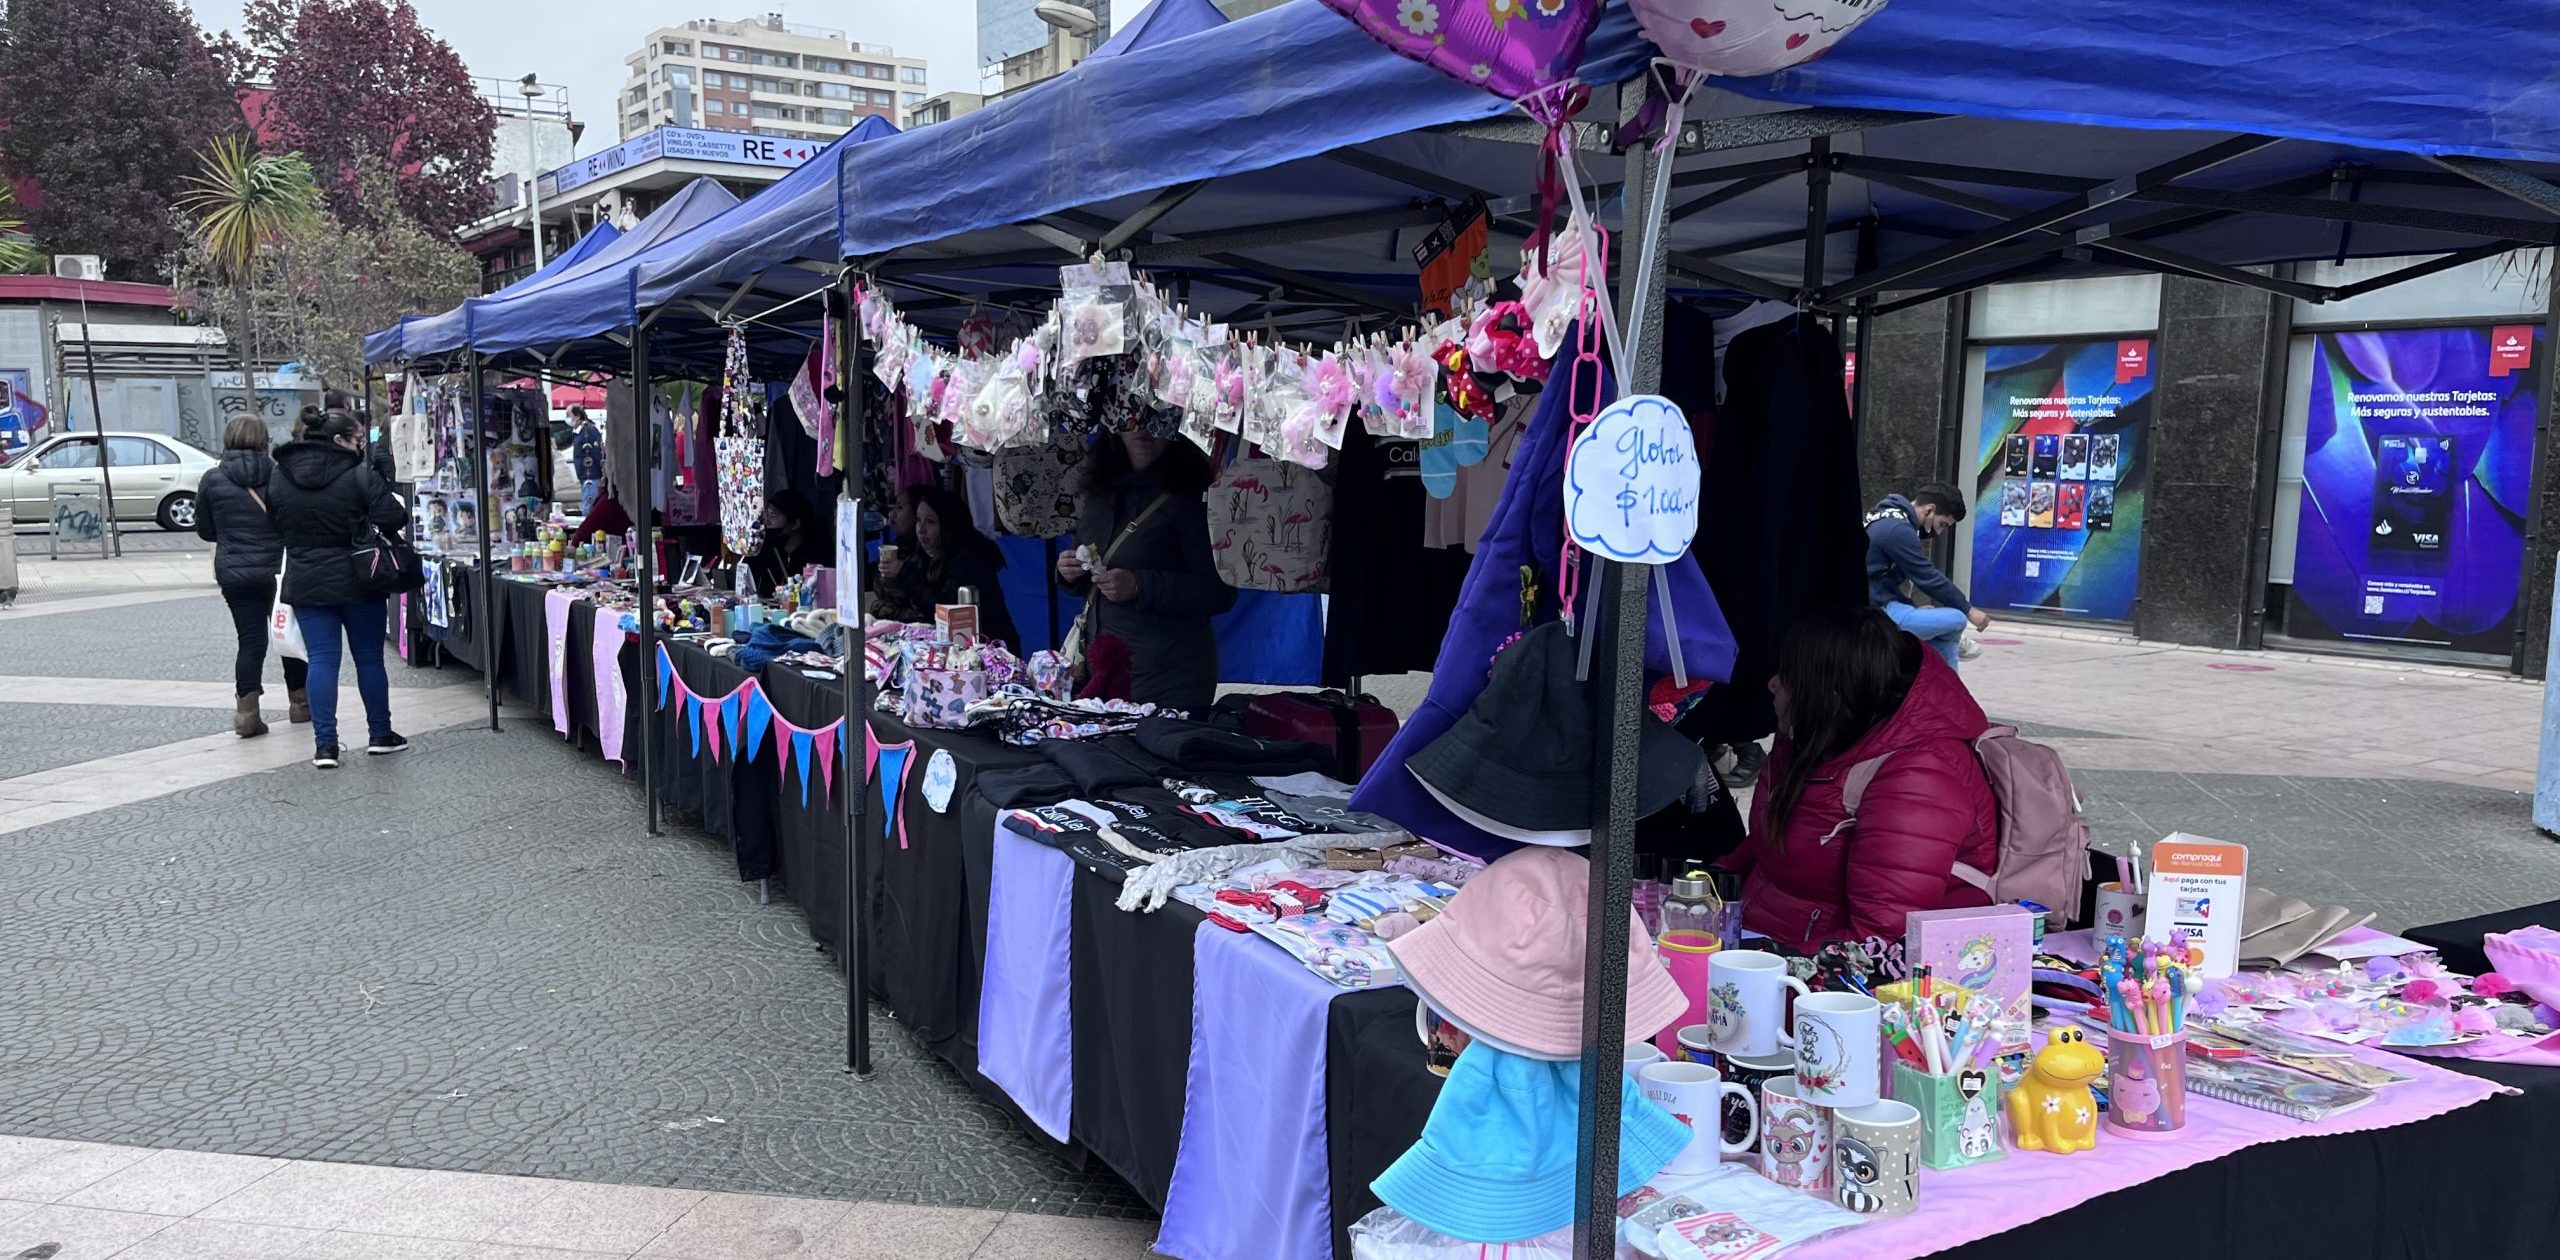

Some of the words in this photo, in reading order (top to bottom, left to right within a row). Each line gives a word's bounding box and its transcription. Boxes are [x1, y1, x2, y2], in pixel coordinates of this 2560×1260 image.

[743, 139, 776, 160] RE
[2010, 396, 2053, 406] Renovamos
[2053, 395, 2087, 405] nuestras
[2347, 392, 2405, 403] Renovamos
[2405, 391, 2451, 402] nuestras
[2451, 390, 2497, 404] Tarjetas:
[2012, 408, 2029, 418] Más
[2029, 410, 2059, 419] seguras
[2059, 410, 2066, 419] y
[2350, 405, 2372, 418] Más
[2373, 407, 2413, 419] seguras
[2413, 407, 2421, 419] y
[2412, 533, 2439, 543] VISA
[2180, 877, 2199, 886] paga
[2179, 886, 2209, 894] tarjetas
[2183, 928, 2204, 938] ISA
